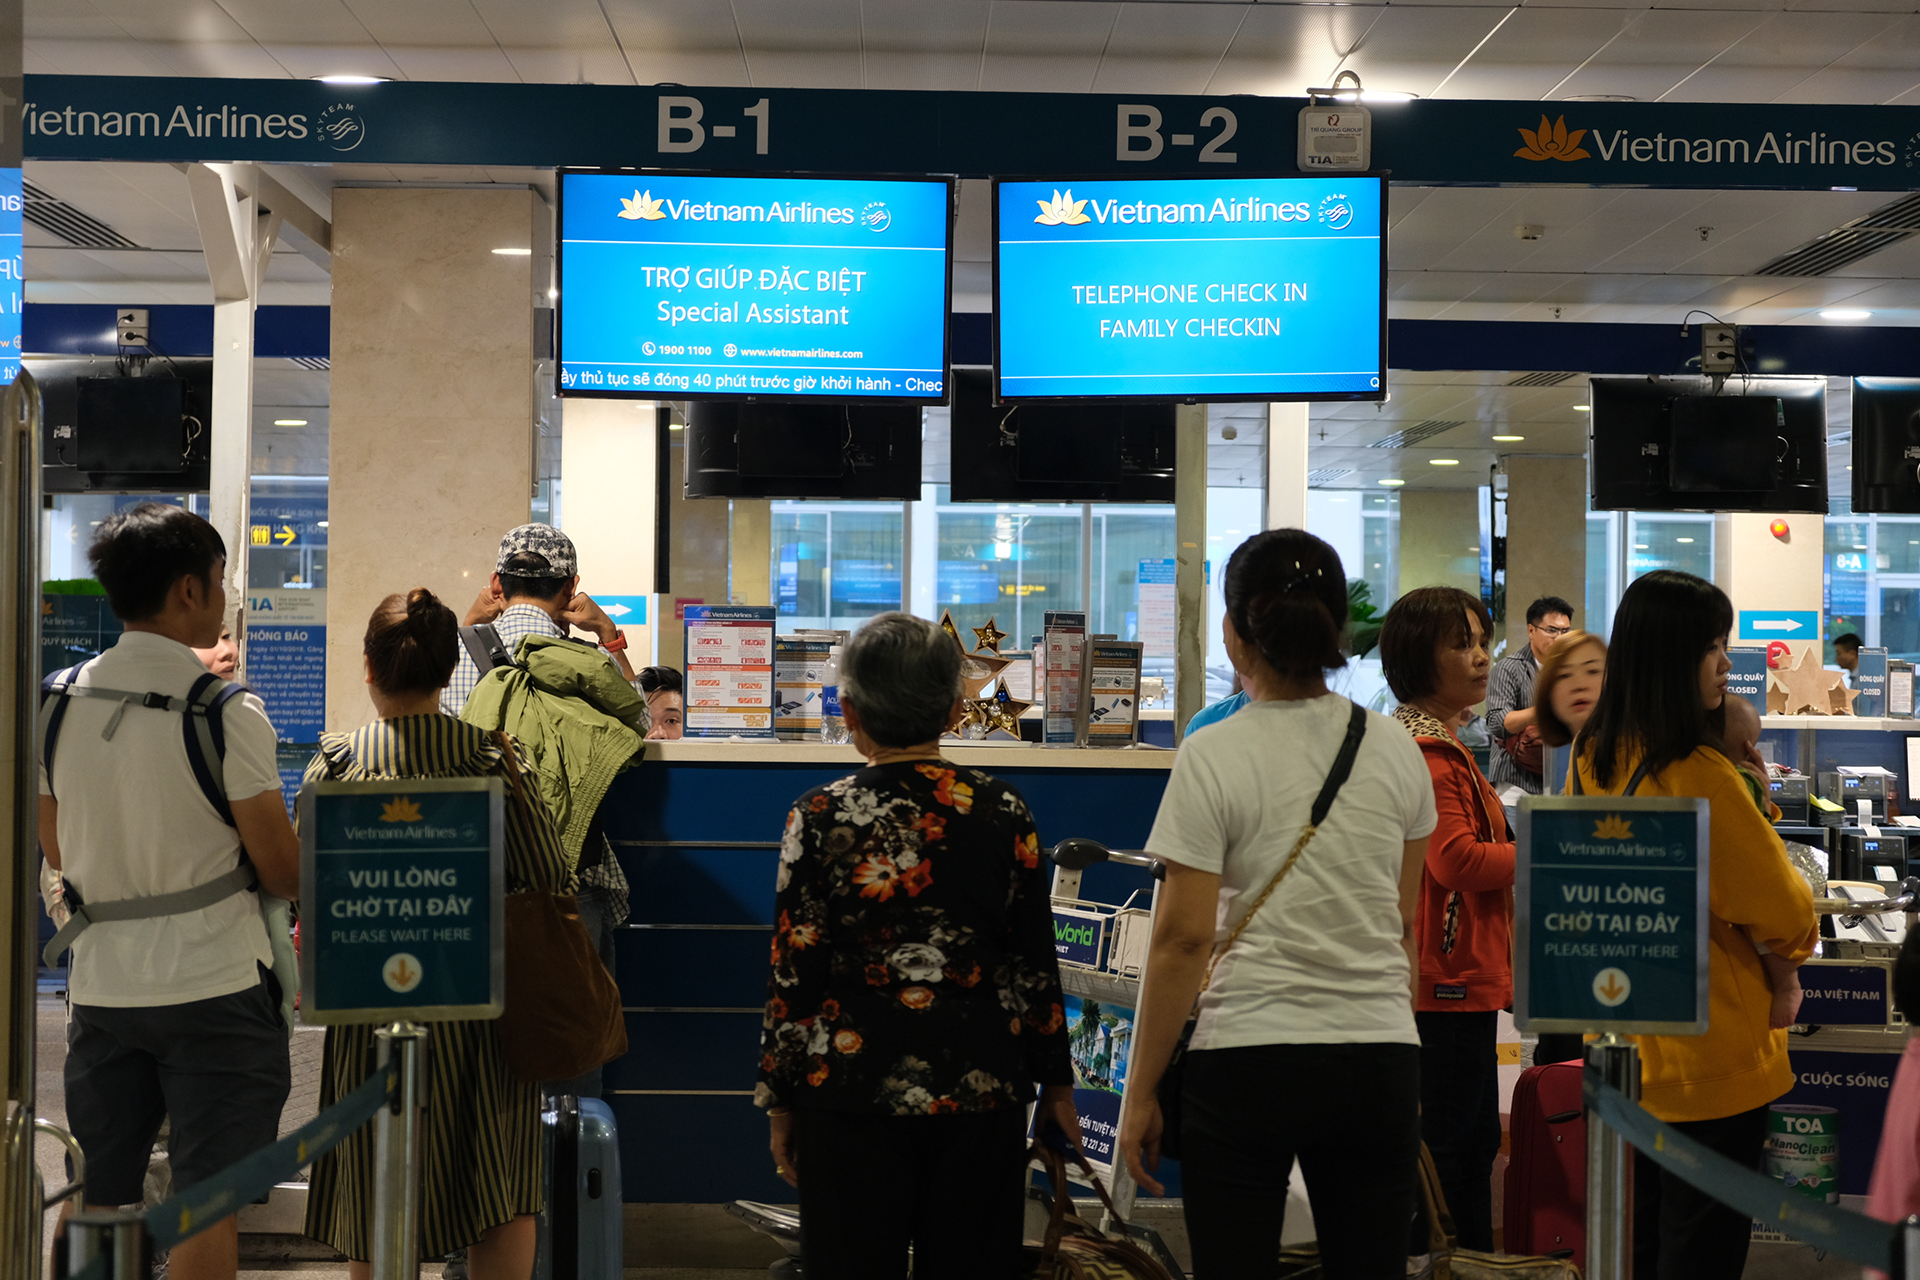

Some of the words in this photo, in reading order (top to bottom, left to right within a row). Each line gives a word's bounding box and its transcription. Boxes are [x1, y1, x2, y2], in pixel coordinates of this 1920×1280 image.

[164, 104, 309, 140] Airlines
[315, 102, 356, 143] SKYTEAM
[656, 95, 770, 156] B-1
[1115, 103, 1239, 164] B-2
[1592, 128, 1750, 164] Vietnam
[1754, 131, 1897, 166] Airlines
[1308, 156, 1333, 165] TIA
[666, 198, 765, 223] Vietnam
[766, 200, 855, 225] Airlines
[1091, 198, 1207, 225] Vietnam
[1209, 196, 1311, 223] Airlines
[1318, 193, 1348, 224] SKYTEAM
[641, 266, 690, 294] TRỢ
[695, 264, 754, 291] GIÚP
[758, 265, 811, 297] ĐẶC
[816, 266, 867, 297] BIỆT
[1072, 284, 1199, 305] TELEPHONE
[1204, 282, 1278, 303] CHECK
[1284, 282, 1308, 302] IN
[657, 299, 740, 328] Special
[745, 302, 851, 327] Assistant
[1099, 318, 1179, 339] FAMILY
[1184, 317, 1281, 338] CHECKIN
[658, 343, 685, 356] 1900
[687, 344, 712, 356] 1100
[740, 346, 864, 361] www.vietnamairlines.com
[581, 366, 604, 386] thủ
[607, 368, 630, 390] tục
[633, 368, 651, 387] sẽ
[654, 368, 690, 392] đóng
[694, 372, 712, 388] 40
[715, 369, 747, 393] phút
[750, 371, 790, 391] trước
[793, 371, 817, 395] giờ
[821, 372, 852, 392] khởi
[855, 373, 892, 392] hành
[61, 636, 92, 647] KHÁCH
[284, 629, 309, 642] BÁO
[1727, 672, 1742, 682] ÓNG
[1727, 686, 1758, 694] CLOSED
[1863, 688, 1881, 696] CLOSED
[344, 826, 404, 840] Vietnam
[405, 825, 457, 839] Airlines
[1559, 842, 1616, 856] Vietnam
[1616, 843, 1666, 858] Airlines
[348, 870, 388, 888] VUI
[394, 865, 457, 888] LÒNG
[1562, 884, 1599, 903] VUI
[1605, 882, 1666, 904] LÒNG
[331, 896, 385, 918] CHỜ
[385, 898, 421, 922] TẠI
[426, 894, 473, 917] ĐÂY
[1054, 919, 1094, 947] World
[1544, 910, 1593, 931] CHỜ
[1595, 914, 1631, 937] TẠI
[1636, 912, 1680, 933] ĐÂY
[331, 929, 387, 943] PLEASE
[391, 928, 429, 942] WAIT
[433, 927, 472, 941] HERE
[1544, 943, 1598, 957] PLEASE
[1602, 943, 1638, 957] WAIT
[1642, 945, 1680, 959] HERE
[1824, 988, 1850, 1001] VIỆT
[1852, 991, 1880, 1001] NAM
[1800, 1071, 1843, 1089] CUỘC
[1846, 1071, 1890, 1089] SỐNG
[1078, 1114, 1092, 1130] ĐẾN
[1091, 1120, 1111, 1137] TUYỆT
[1782, 1116, 1824, 1134] TOA
[1087, 1138, 1099, 1151] 221
[1097, 1141, 1110, 1154] 226
[1770, 1137, 1836, 1155] NanoClean
